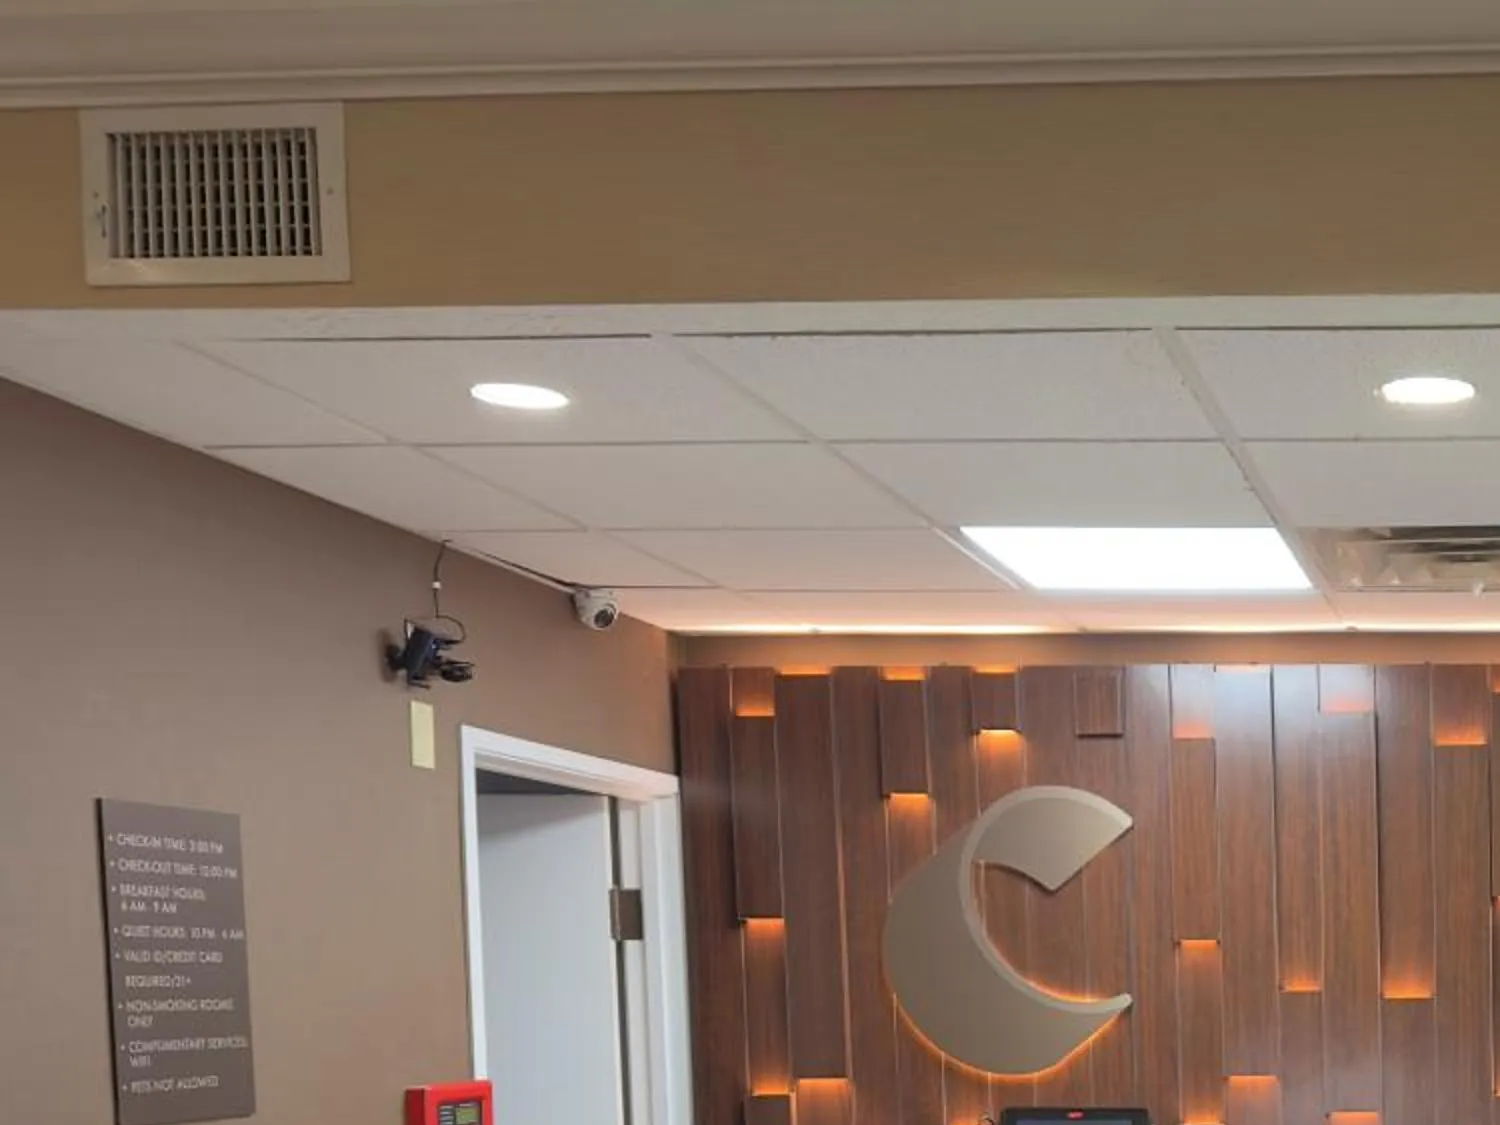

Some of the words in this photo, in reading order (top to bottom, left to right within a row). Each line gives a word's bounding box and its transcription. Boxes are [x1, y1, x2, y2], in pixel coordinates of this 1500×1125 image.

[129, 901, 146, 912] AM
[162, 902, 178, 913] AM
[124, 950, 151, 962] VALID
[199, 951, 223, 963] CARD
[153, 1077, 174, 1092] NOT
[177, 1074, 219, 1089] ALLOWED
